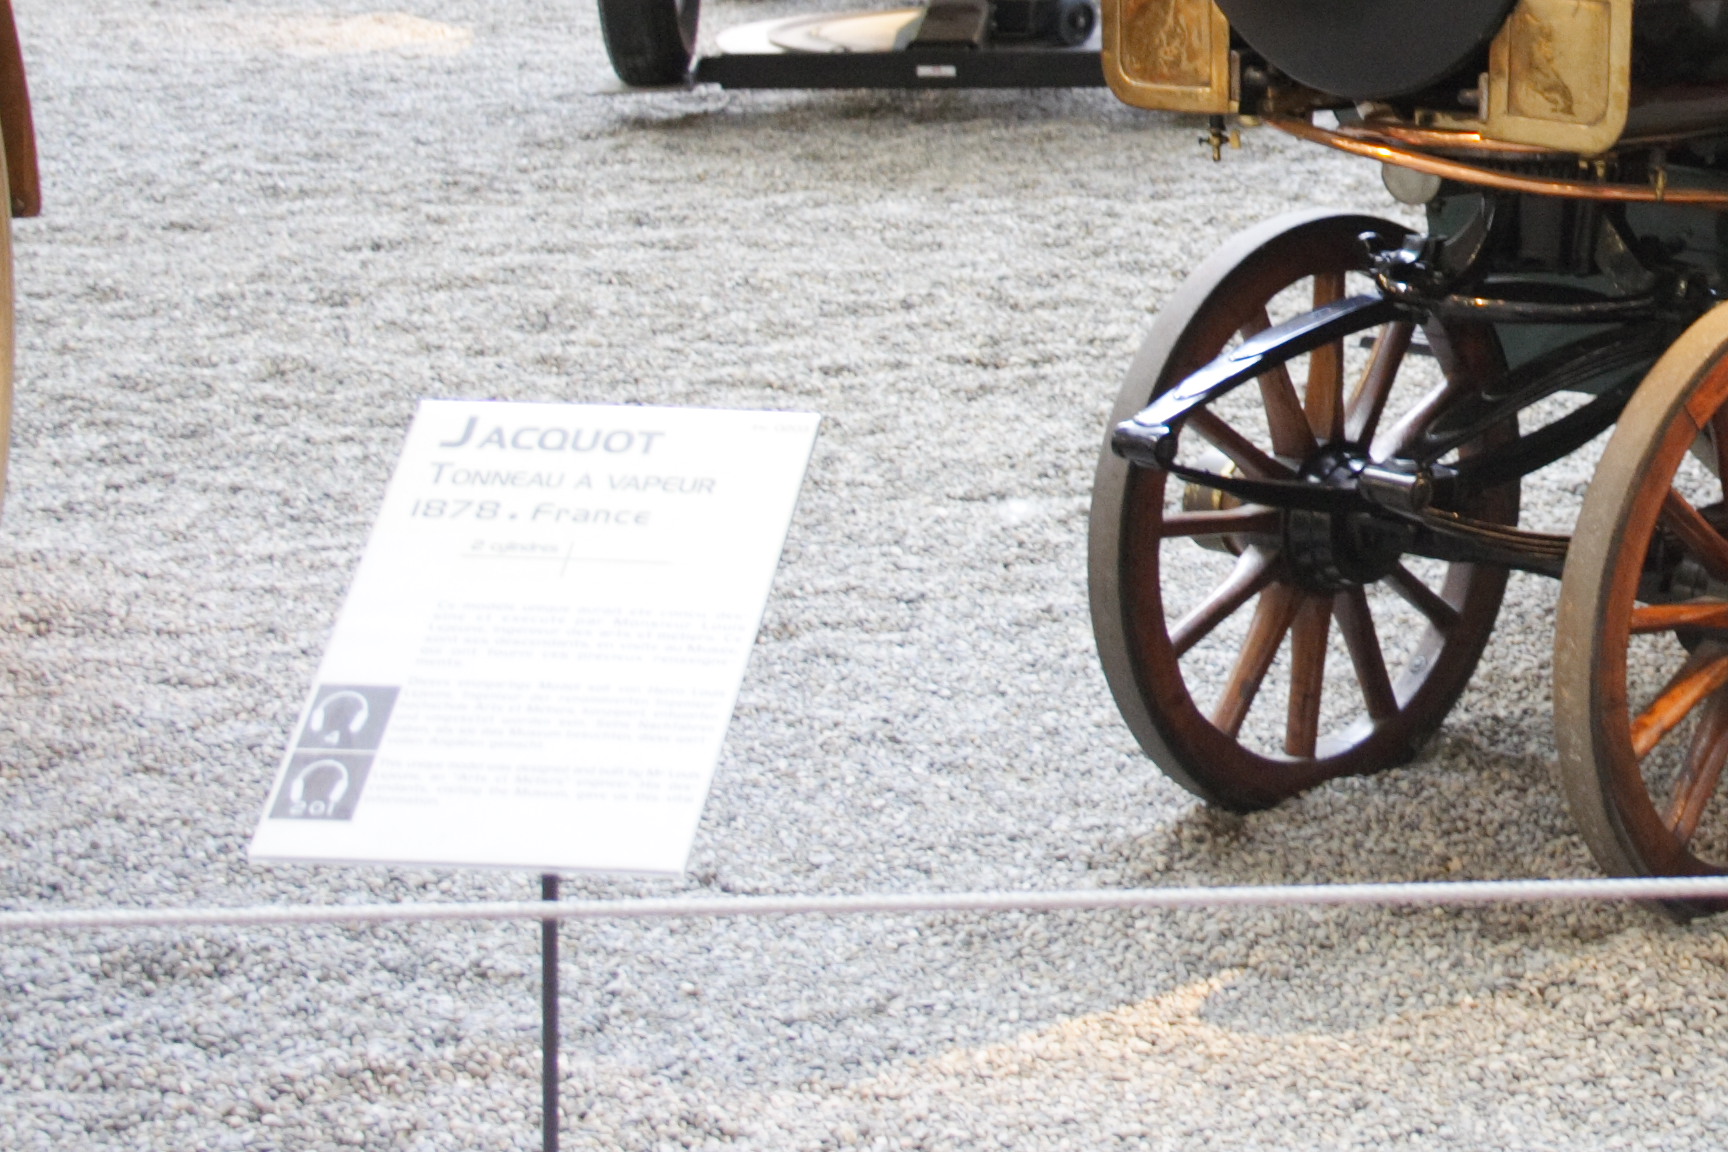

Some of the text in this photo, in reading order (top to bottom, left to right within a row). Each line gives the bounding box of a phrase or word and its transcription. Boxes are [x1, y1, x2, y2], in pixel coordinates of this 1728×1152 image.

[440, 416, 665, 454] JACQUOT
[430, 462, 565, 489] TONNEAU
[607, 474, 717, 496] VAPEUR
[530, 501, 654, 526] France
